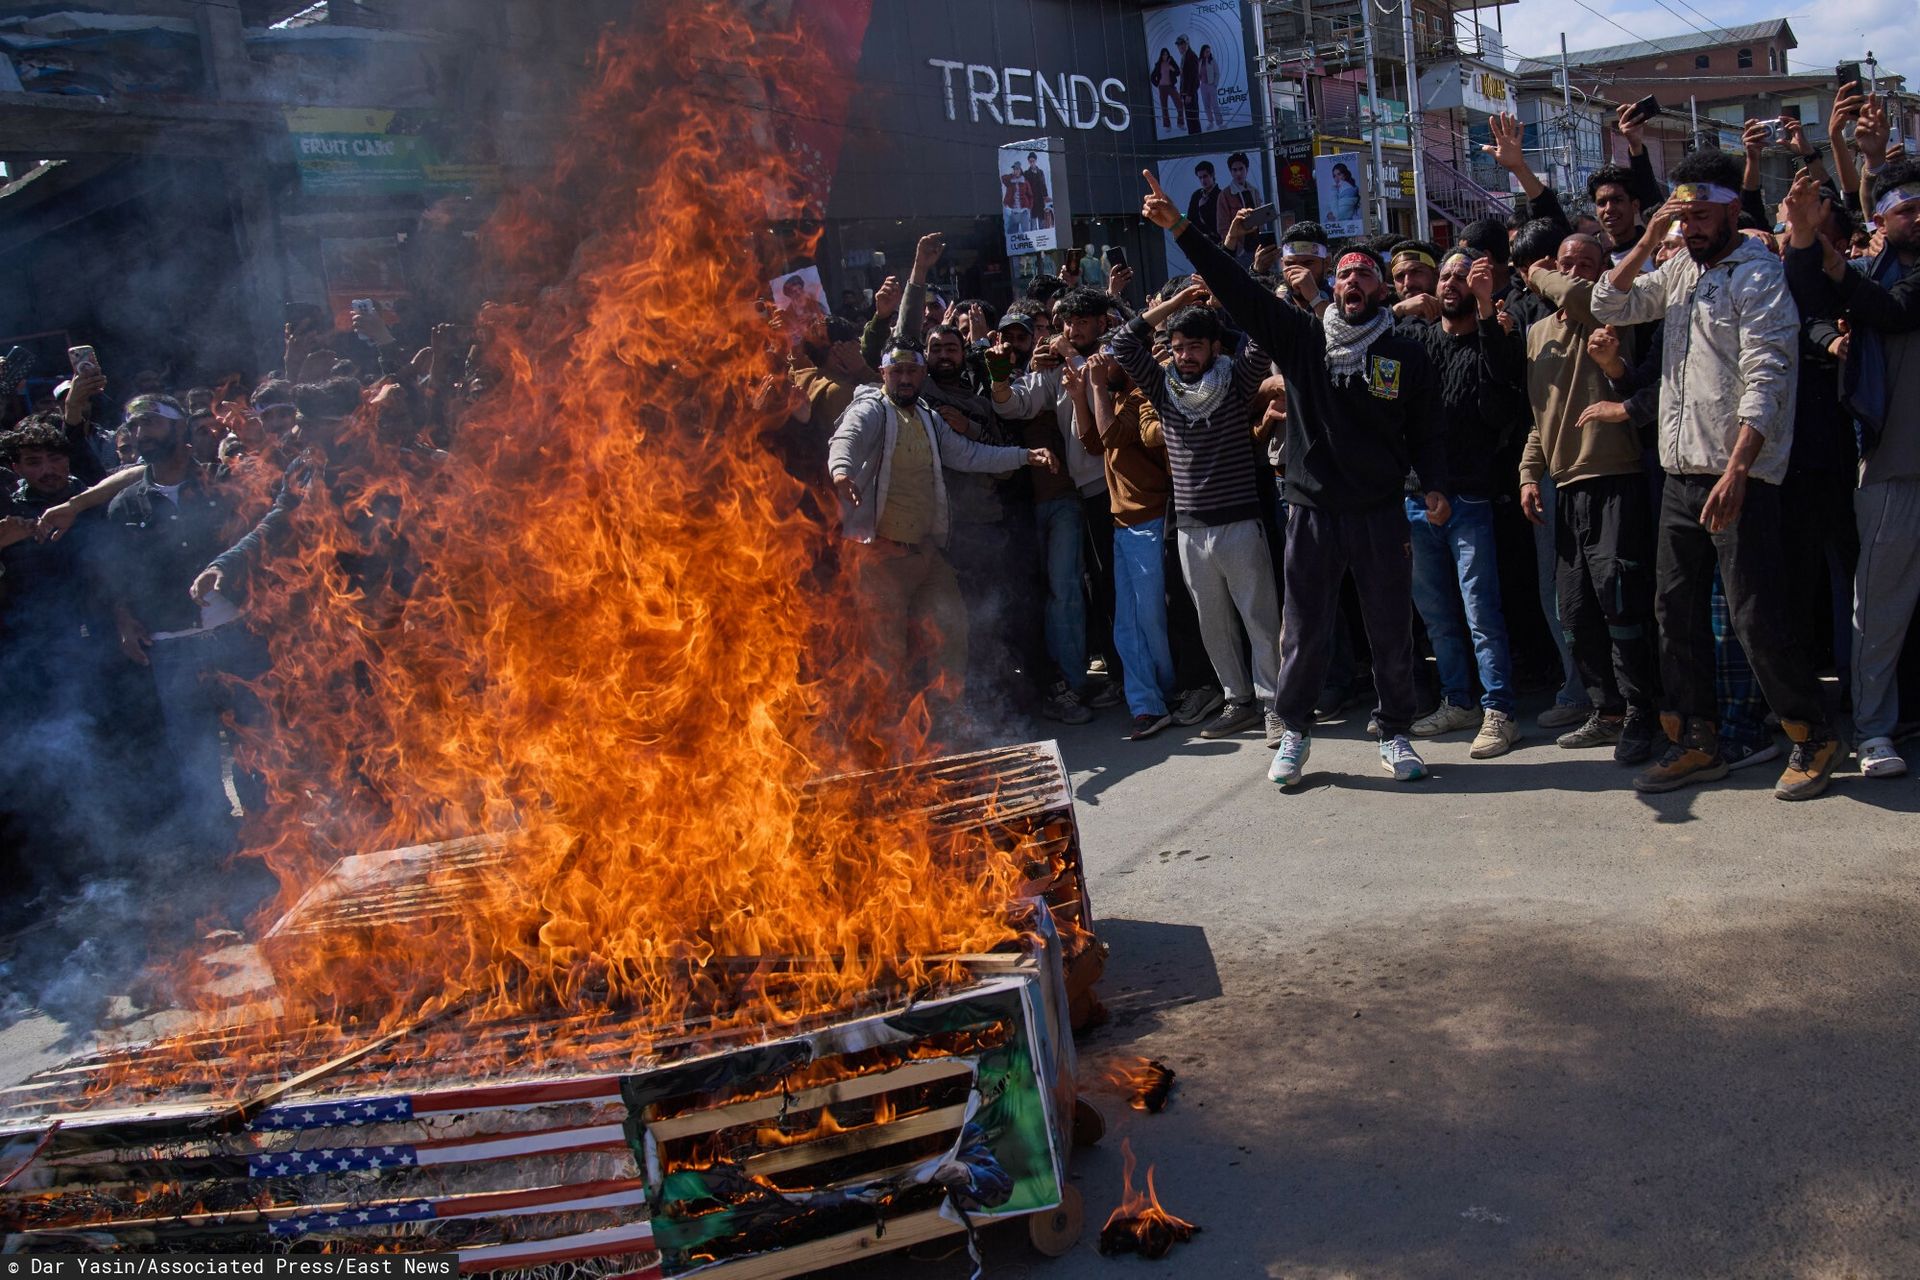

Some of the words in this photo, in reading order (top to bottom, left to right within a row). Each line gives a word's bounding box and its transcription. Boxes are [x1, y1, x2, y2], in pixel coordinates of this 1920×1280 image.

[1196, 1, 1236, 14] TRENDS
[929, 58, 1130, 131] TRENDS
[1217, 85, 1242, 96] CHILL
[300, 138, 347, 155] FRUIT
[1289, 143, 1311, 154] Choice
[1010, 233, 1030, 242] CHILL
